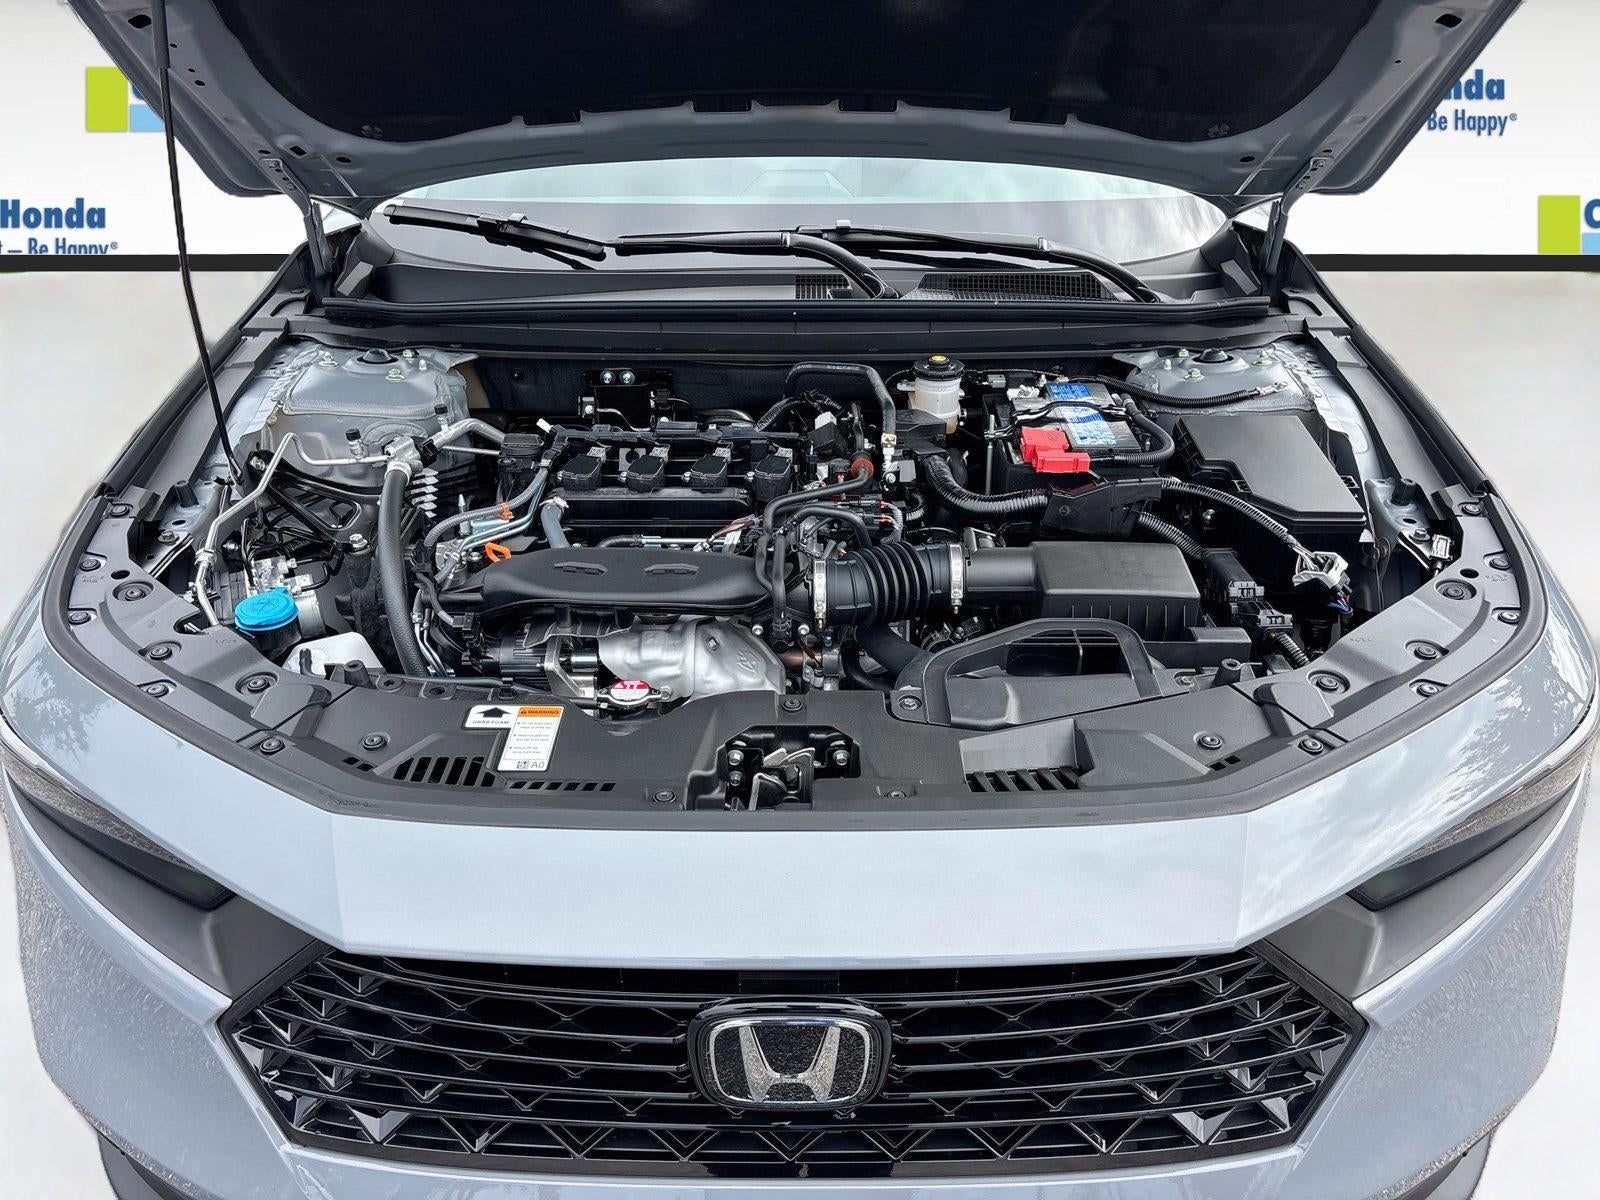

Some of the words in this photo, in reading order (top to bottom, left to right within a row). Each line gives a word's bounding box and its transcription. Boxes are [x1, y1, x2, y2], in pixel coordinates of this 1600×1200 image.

[1443, 69, 1505, 100] nda
[1427, 110, 1448, 131] Be
[0, 197, 106, 229] Honda
[28, 237, 49, 255] Be
